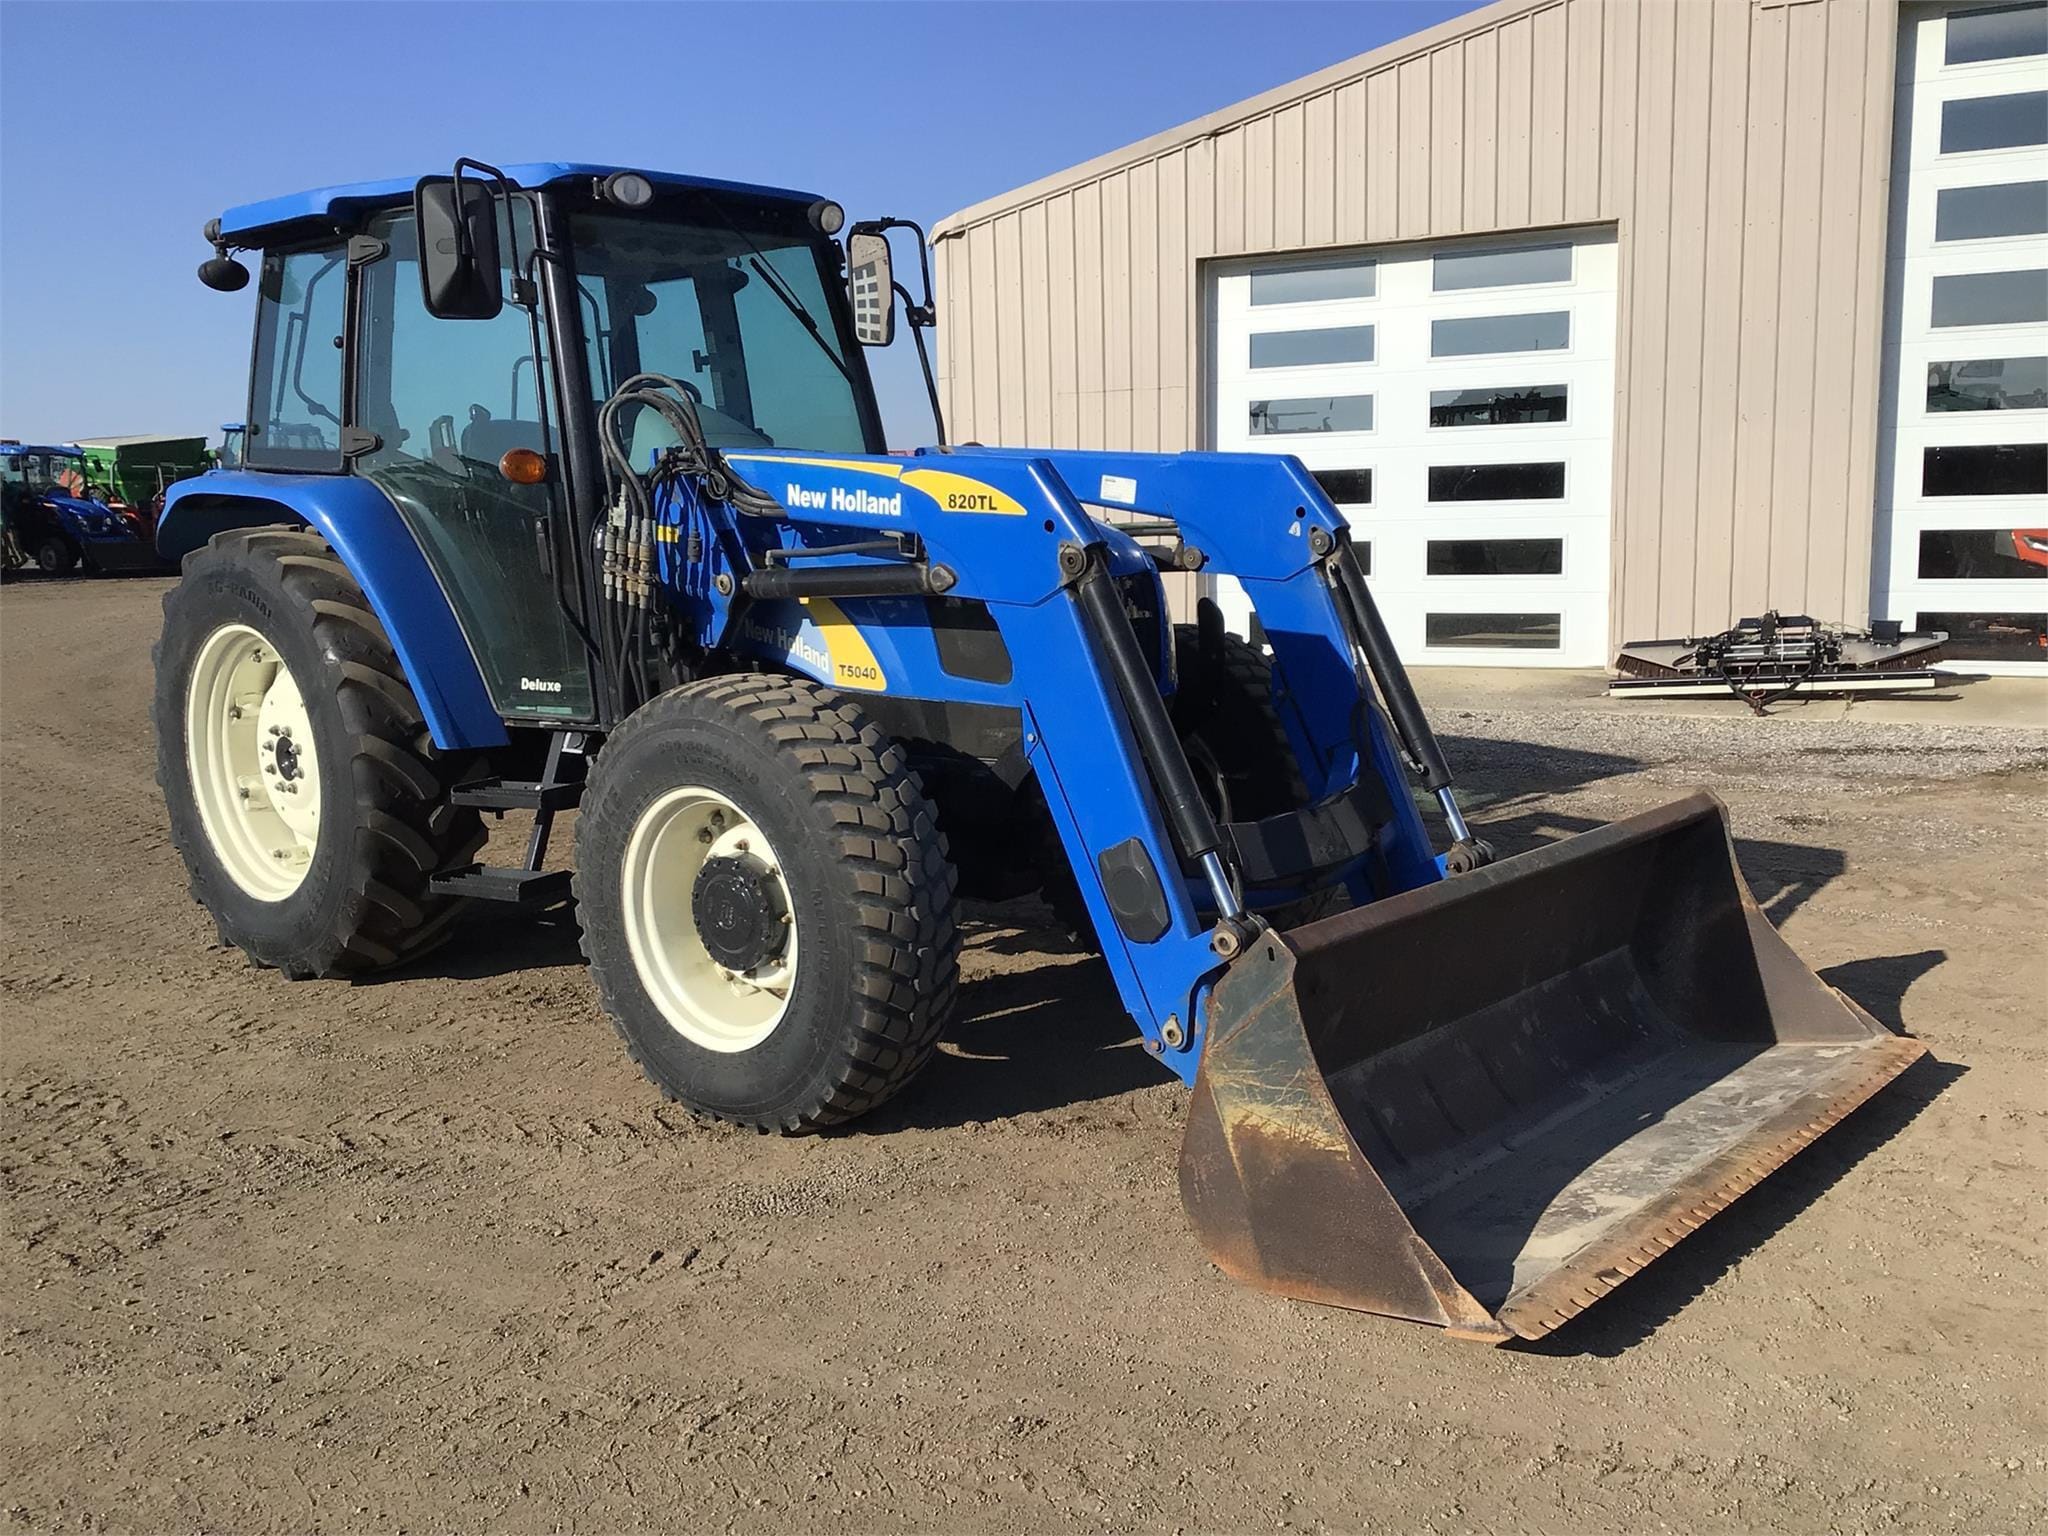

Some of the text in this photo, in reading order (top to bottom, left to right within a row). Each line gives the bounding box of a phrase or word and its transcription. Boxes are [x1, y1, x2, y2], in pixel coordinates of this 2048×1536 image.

[787, 484, 901, 516] New Holland
[948, 494, 997, 511] 820TL
[744, 617, 829, 674] New Holland
[839, 664, 877, 680] T5040
[520, 677, 562, 693] Deluxe
